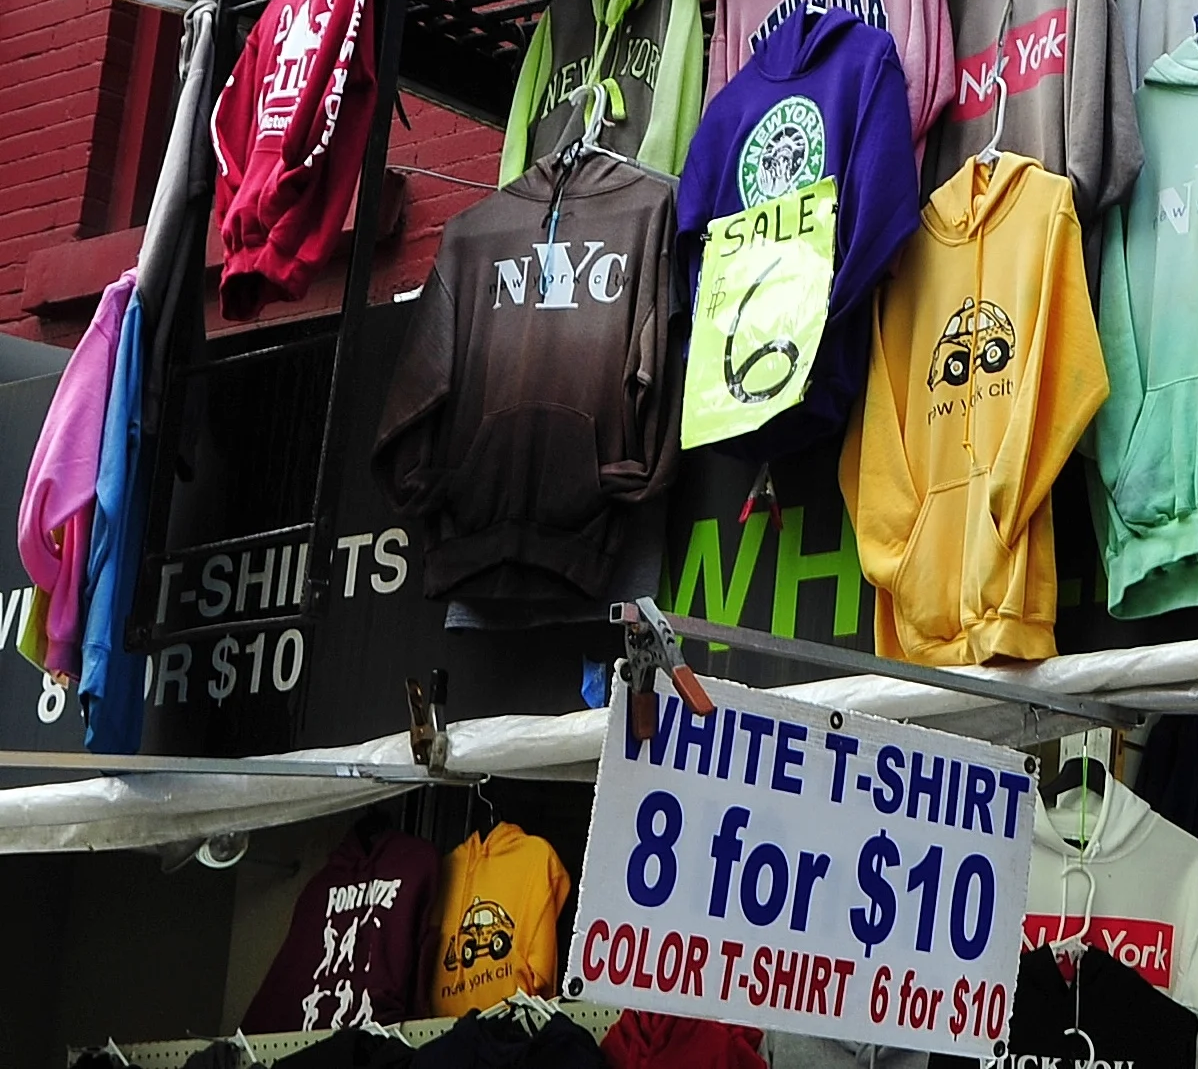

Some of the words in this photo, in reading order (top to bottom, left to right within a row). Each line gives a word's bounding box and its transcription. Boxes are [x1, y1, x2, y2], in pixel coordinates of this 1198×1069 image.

[620, 38, 661, 90] YOR
[1016, 18, 1067, 76] York
[745, 107, 783, 165] NEW
[784, 104, 822, 150] YORK
[720, 193, 816, 258] SALE
[492, 241, 628, 310] NYC
[207, 627, 305, 709] $10
[625, 691, 808, 795] WHITE
[824, 732, 1031, 840] T-SHIRT
[626, 790, 684, 908] 8
[707, 806, 831, 933] for
[849, 829, 995, 960] $10
[468, 968, 494, 992] york
[582, 919, 709, 997] COLOR
[719, 941, 855, 1017] T-SHIRT
[869, 967, 889, 1024] 6
[899, 964, 943, 1029] for
[948, 974, 1007, 1042] $10
[1101, 928, 1169, 972] York
